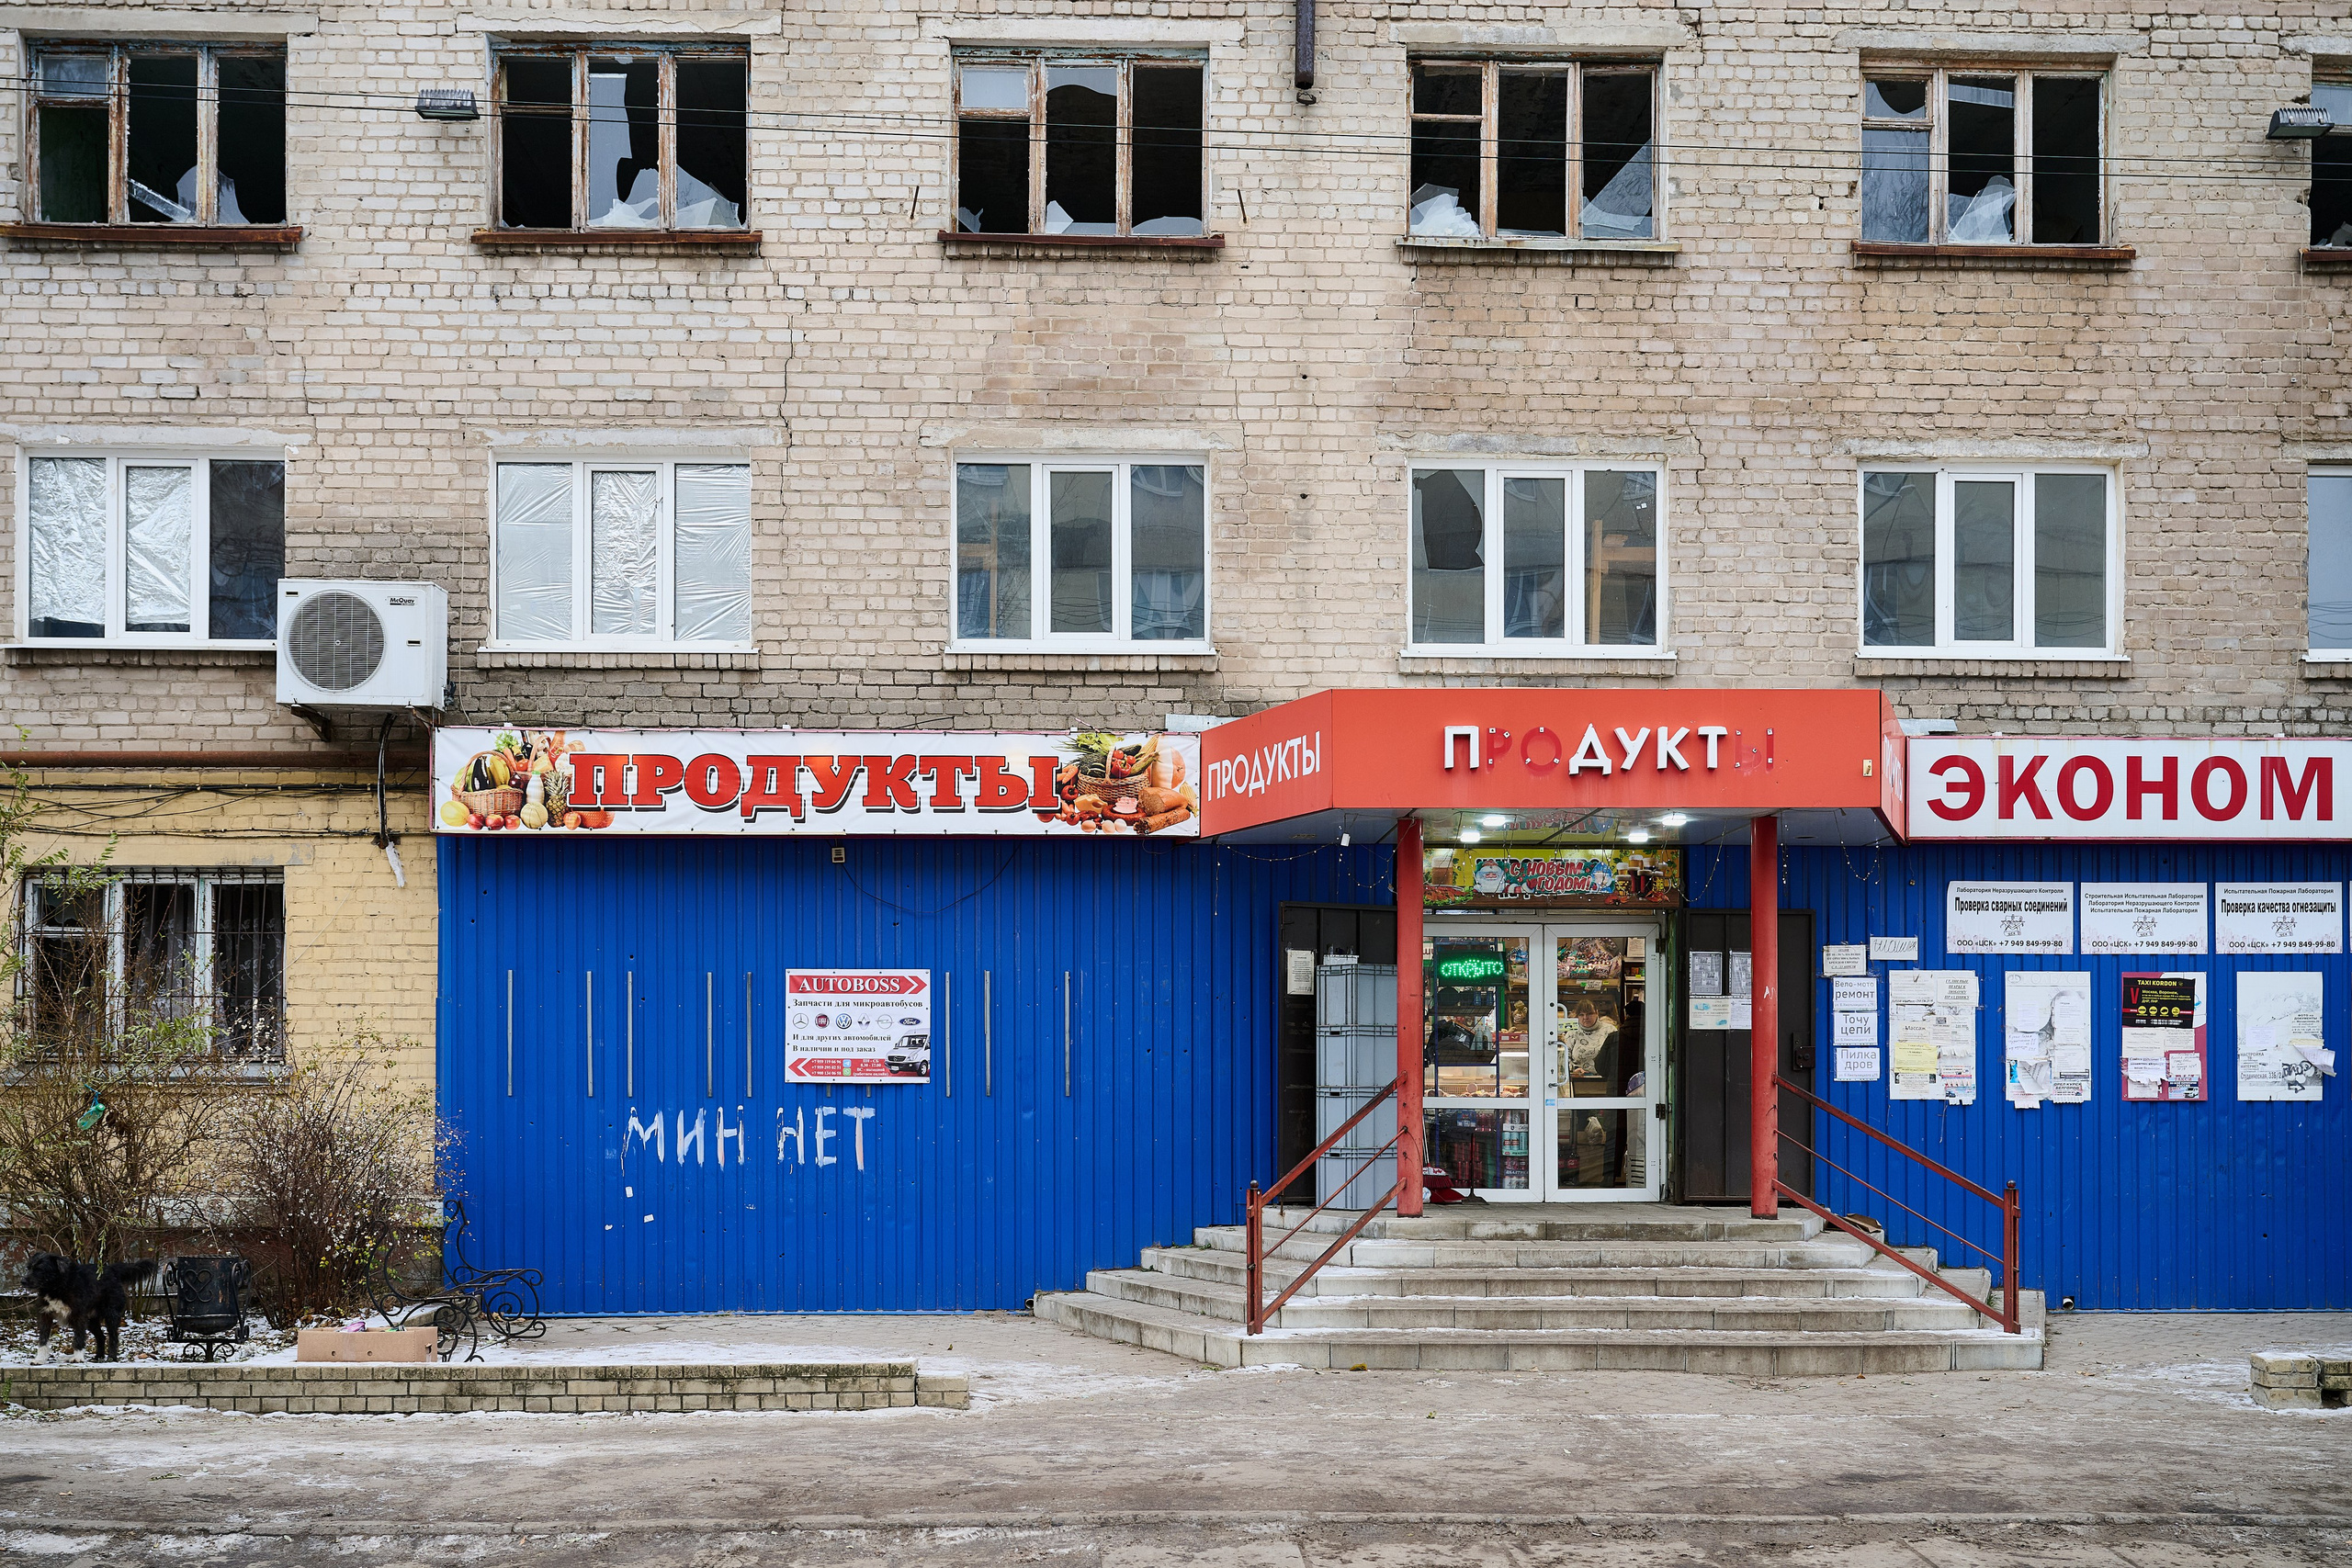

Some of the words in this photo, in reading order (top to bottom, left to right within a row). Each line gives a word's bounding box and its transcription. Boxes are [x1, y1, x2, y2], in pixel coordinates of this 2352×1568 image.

[1207, 731, 1320, 802] ПРОДУКТЫ
[568, 752, 1063, 822] ПРОДУКТЫ
[1927, 754, 2334, 821] ЭКОНОМ
[1510, 863, 1521, 876] С
[1527, 862, 1583, 875] НОВЫМ
[1536, 876, 1591, 892] ГОДОМ!
[1955, 897, 1989, 915] Проверка
[1991, 900, 2022, 913] сварных
[2025, 898, 2067, 914] соединений
[2222, 899, 2256, 917] Проверка
[2257, 902, 2290, 913] качества
[2292, 902, 2336, 915] огнезащиты
[1442, 959, 1503, 977] ОТКРЫТО
[798, 977, 900, 993] AUTOBOSS
[1836, 991, 1874, 1000] ремонт
[853, 999, 923, 1009] микроавтобусов
[1843, 1014, 1869, 1026] Точу
[1841, 1026, 1871, 1035] цепи
[1841, 1049, 1876, 1059] Пилка
[1845, 1061, 1872, 1071] дров
[620, 1105, 744, 1172] МИН
[776, 1106, 876, 1172] НЕТ
